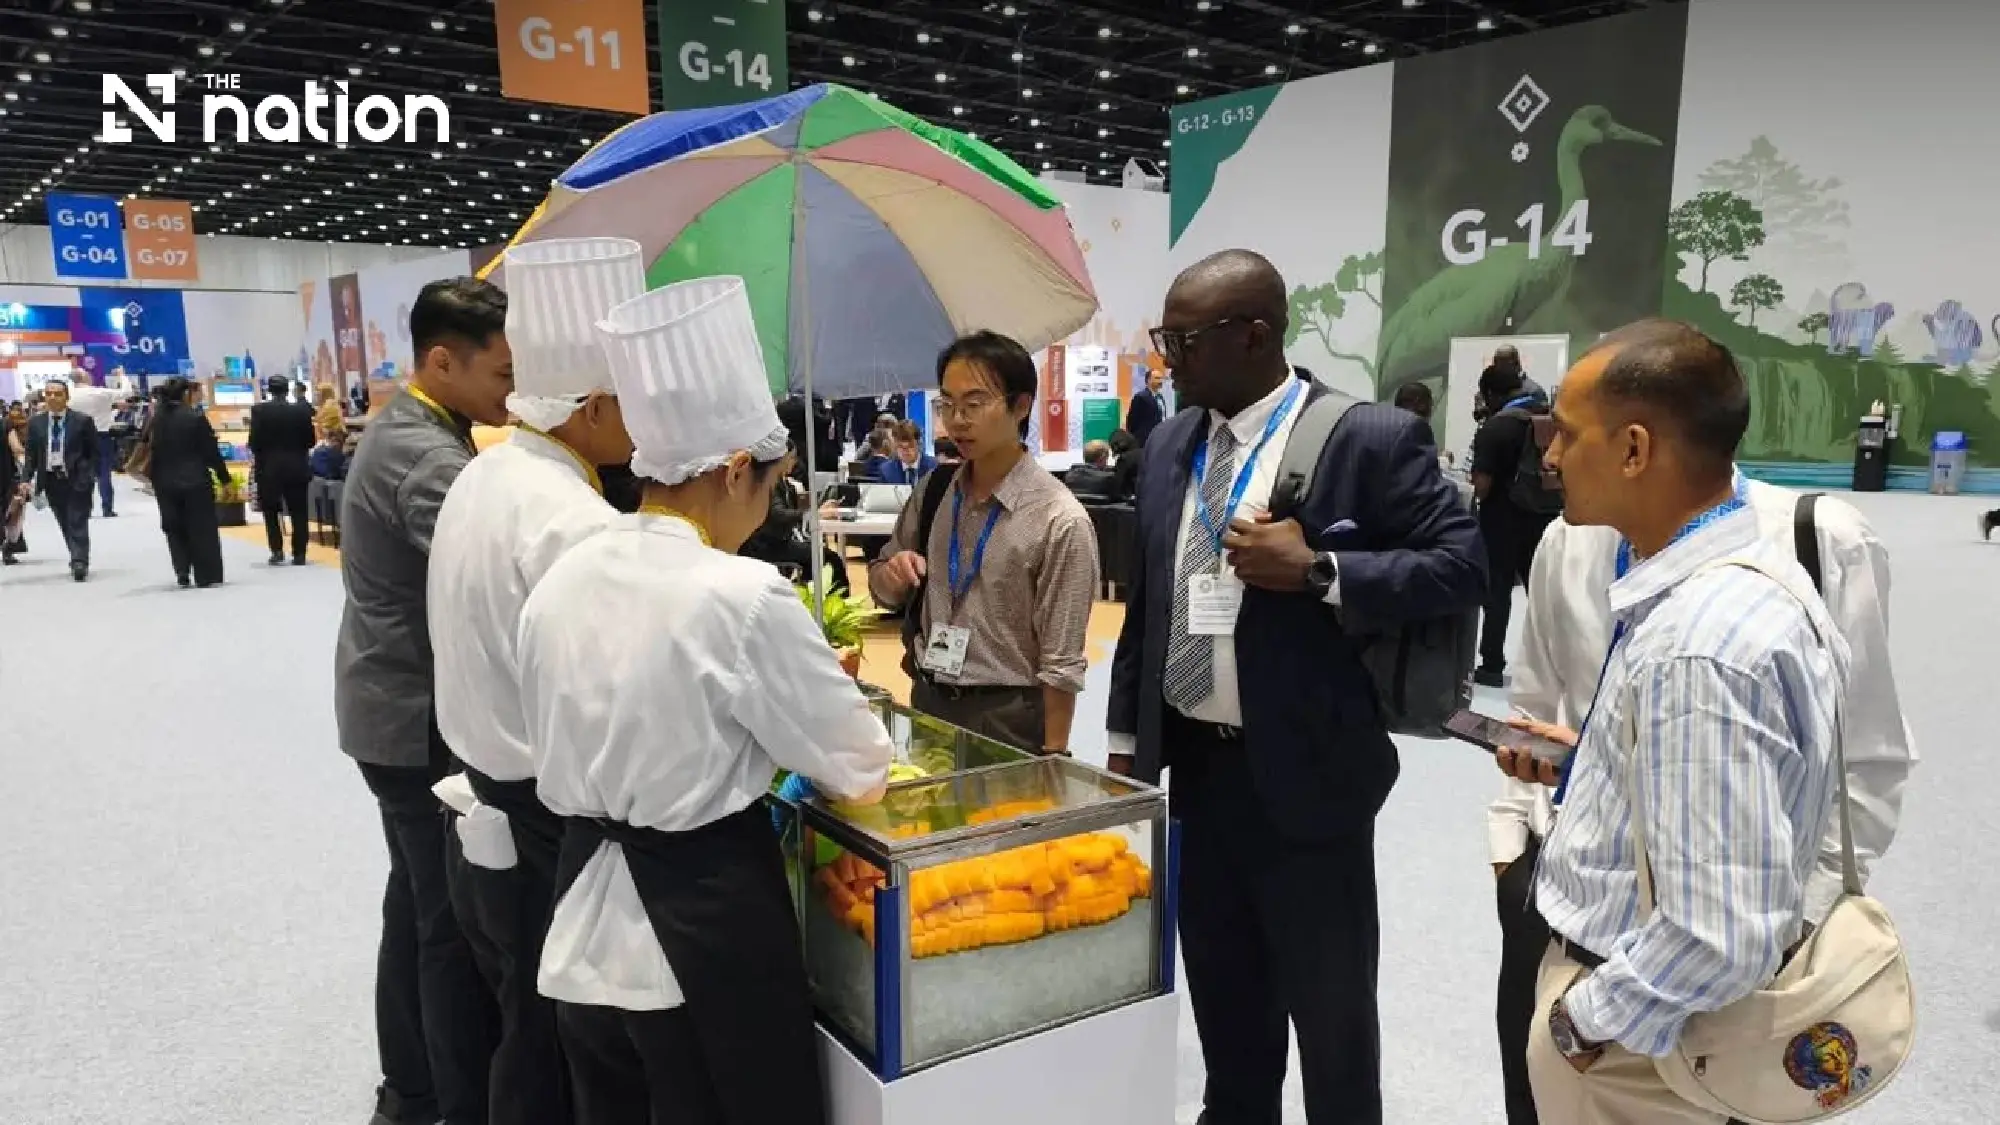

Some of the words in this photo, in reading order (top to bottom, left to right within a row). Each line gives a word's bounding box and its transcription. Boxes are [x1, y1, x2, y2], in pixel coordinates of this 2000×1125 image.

[519, 16, 621, 70] G-11
[679, 41, 773, 91] G-14
[1178, 113, 1209, 133] G-12
[1221, 105, 1255, 125] G-13
[57, 208, 110, 229] G-01
[133, 214, 186, 232] G-05
[1441, 199, 1593, 266] G-14
[61, 245, 118, 264] G-04
[137, 249, 189, 266] G-07
